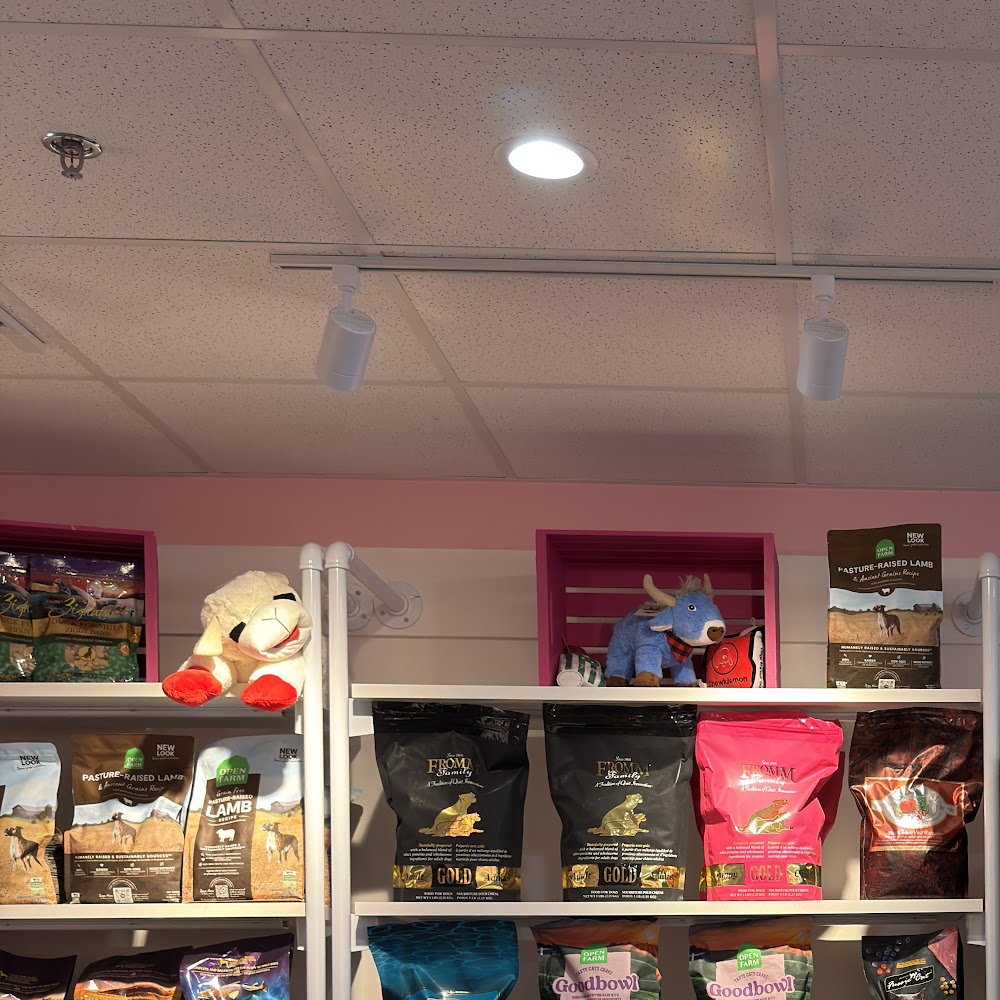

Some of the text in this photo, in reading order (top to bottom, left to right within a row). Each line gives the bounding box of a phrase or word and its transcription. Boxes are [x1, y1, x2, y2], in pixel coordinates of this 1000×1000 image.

[838, 559, 934, 574] PASTURE-RAISED LAMB
[82, 771, 154, 782] PASTURE-RAISED
[219, 768, 246, 776] OPEN
[436, 768, 472, 777] Family
[596, 760, 650, 777] FROMM
[605, 772, 640, 780] Family
[742, 764, 796, 782] FROMM
[218, 774, 245, 783] FARM
[206, 800, 252, 818] LAMB
[437, 867, 472, 884] GOLD
[604, 866, 637, 883] GOLD
[750, 865, 783, 882] GOLD
[740, 960, 760, 968] FARM
[556, 974, 638, 992] Goodbowl
[709, 976, 794, 998] Goodbowl
